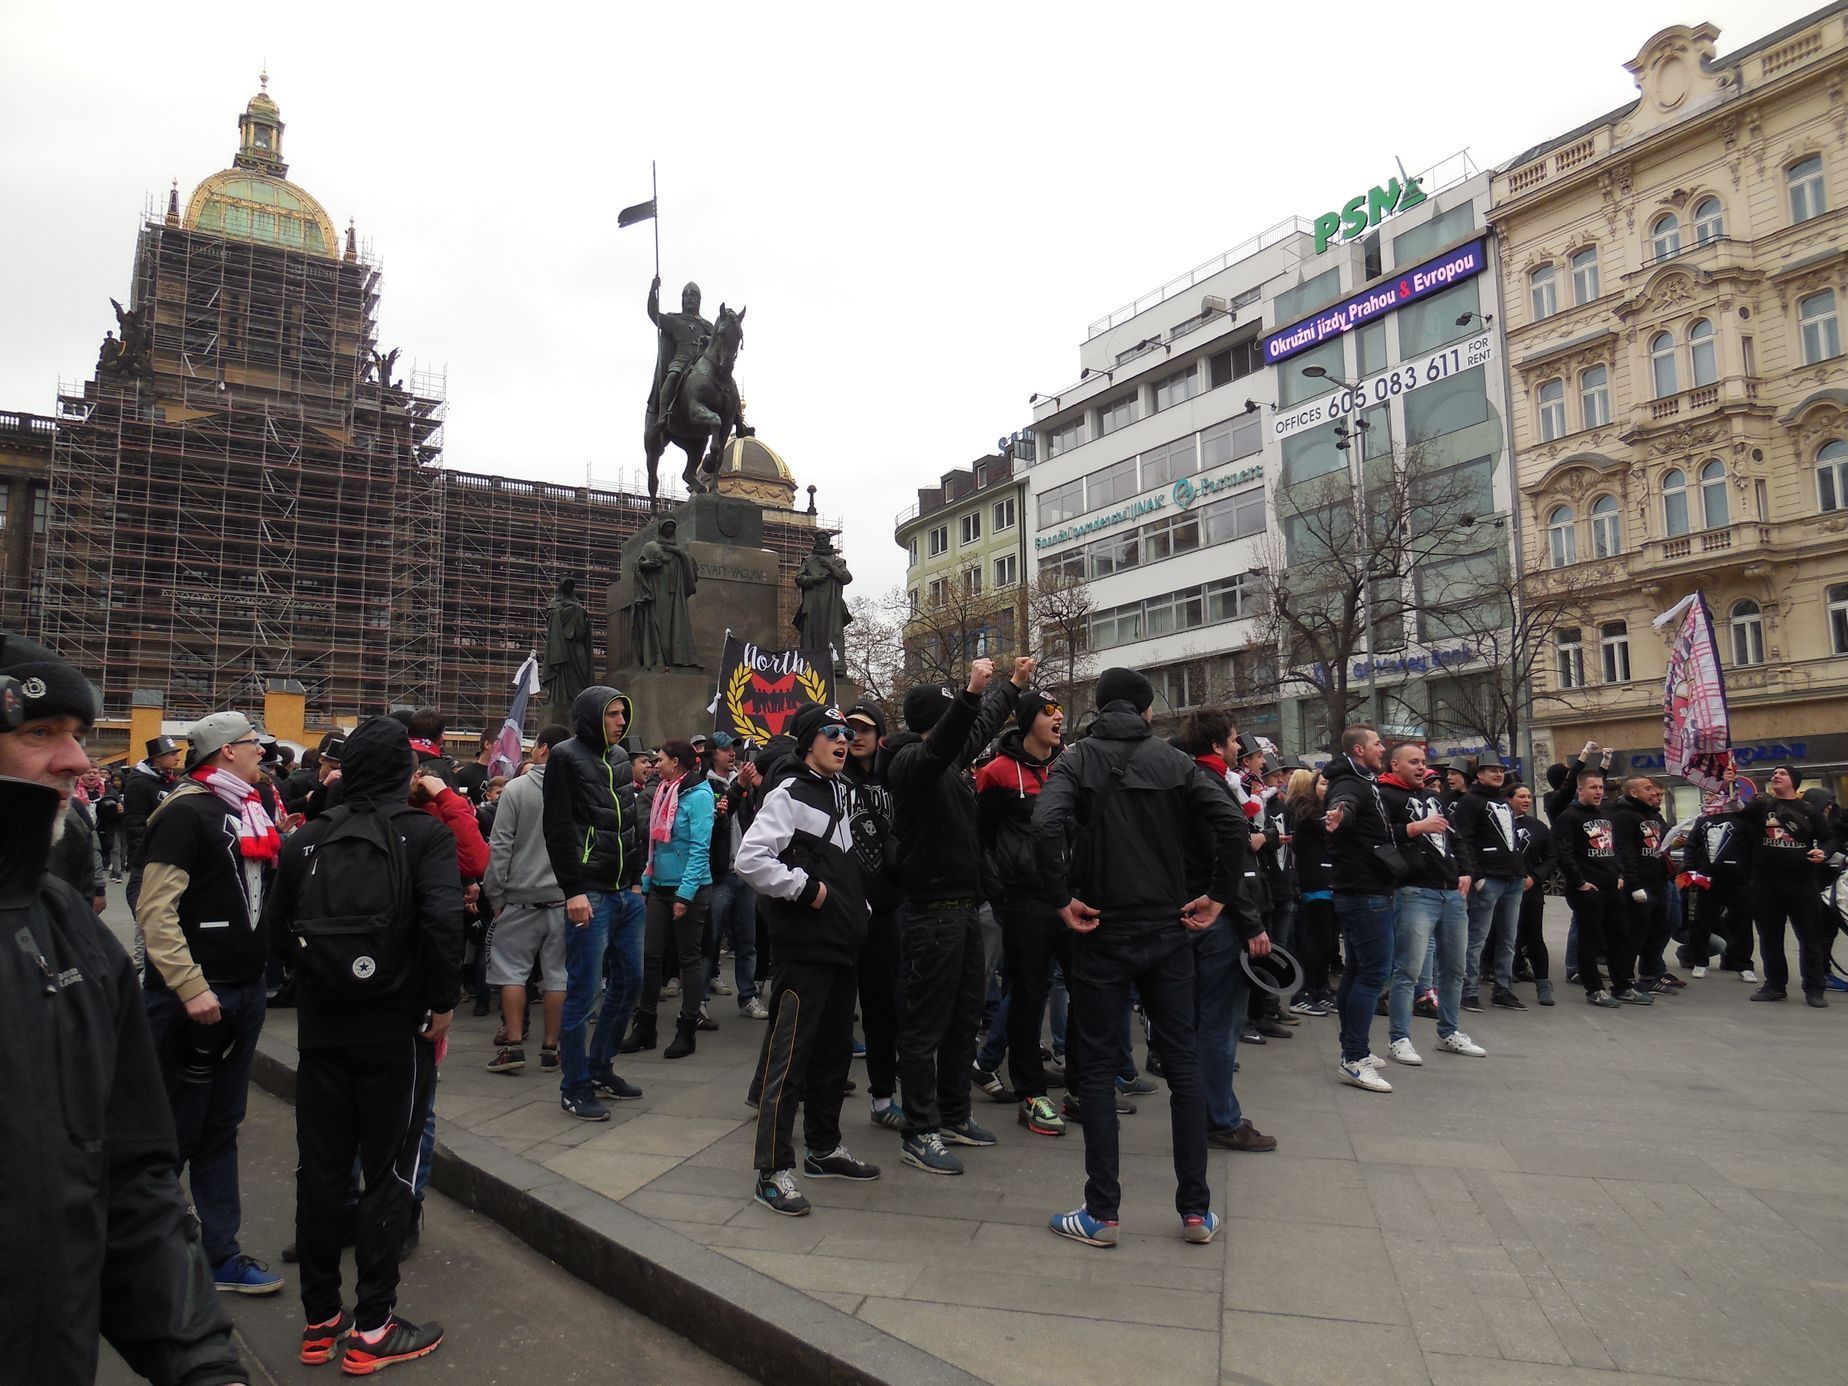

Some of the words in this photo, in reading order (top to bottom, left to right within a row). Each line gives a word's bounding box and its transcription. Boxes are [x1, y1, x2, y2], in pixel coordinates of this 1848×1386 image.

[1270, 323, 1315, 357] Okružní
[1316, 310, 1346, 340] jízdy
[1348, 289, 1396, 321] Prahou
[1399, 280, 1411, 298] &
[1413, 254, 1474, 293] Evropou
[1467, 348, 1492, 367] RENT
[1468, 337, 1489, 353] FOR
[1275, 408, 1322, 434] OFFICES
[1328, 386, 1366, 418] 605
[1374, 366, 1417, 401] 083
[1426, 348, 1460, 382] 611
[744, 642, 810, 676] North
